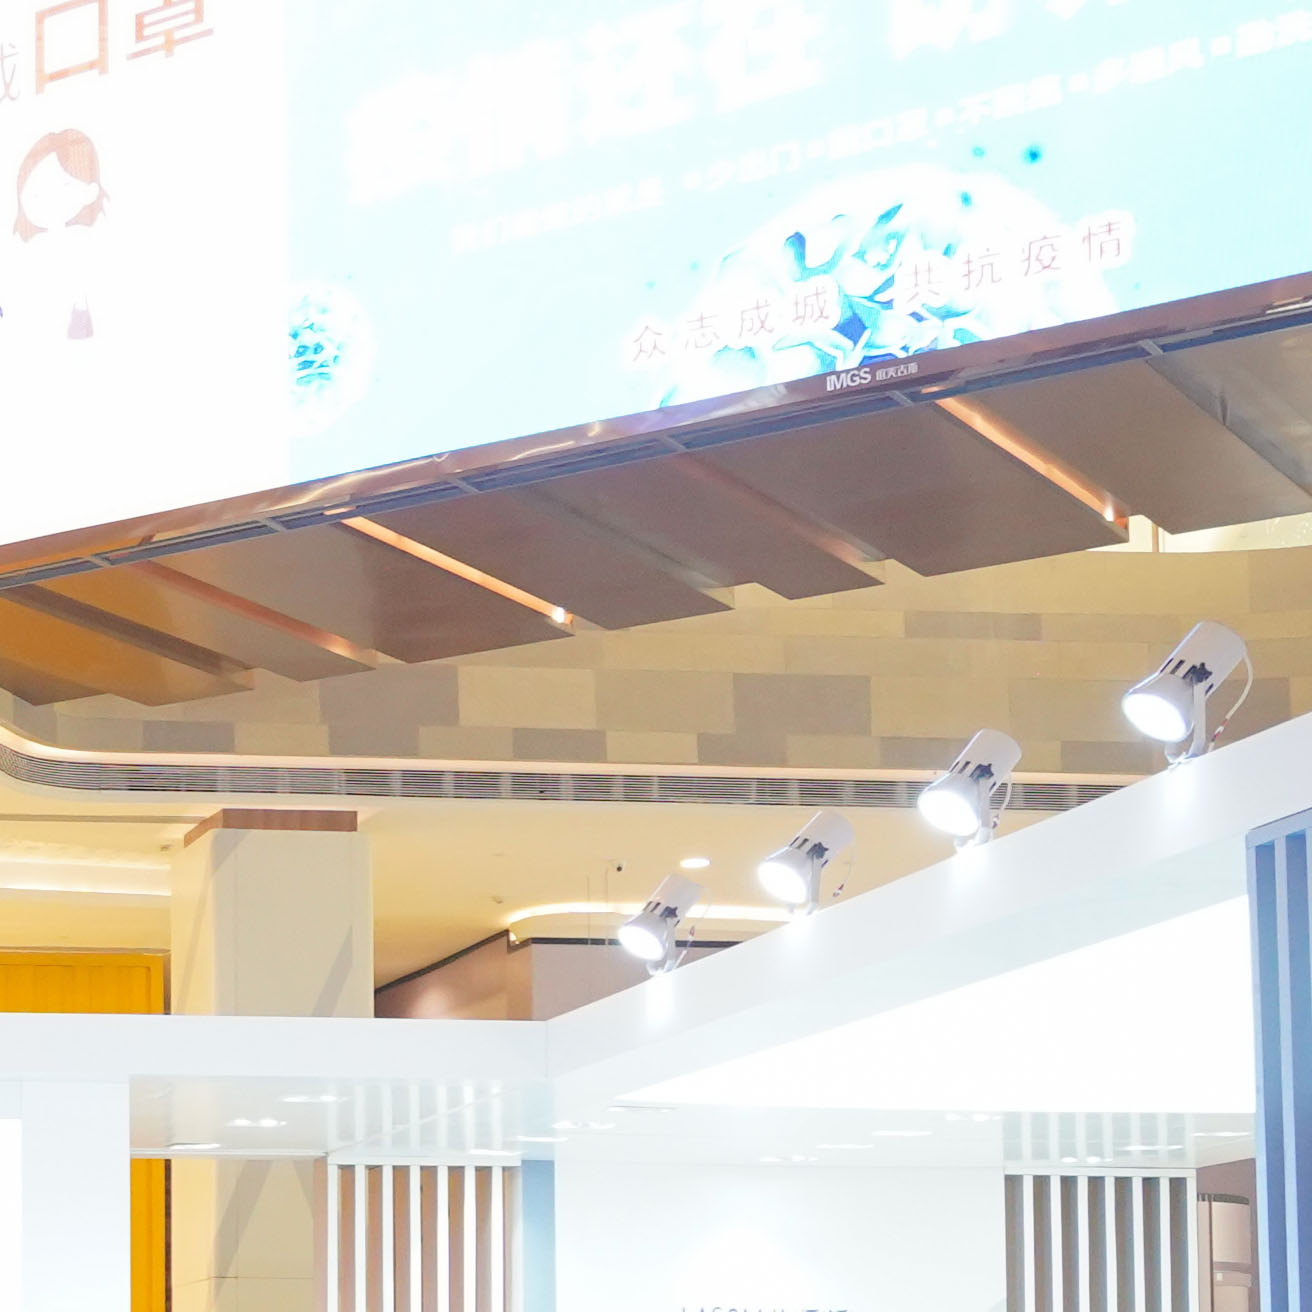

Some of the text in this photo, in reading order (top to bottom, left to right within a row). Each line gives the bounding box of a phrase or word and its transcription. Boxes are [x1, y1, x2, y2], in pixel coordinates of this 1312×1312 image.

[632, 218, 1126, 362] 众志成城 共抗疫情
